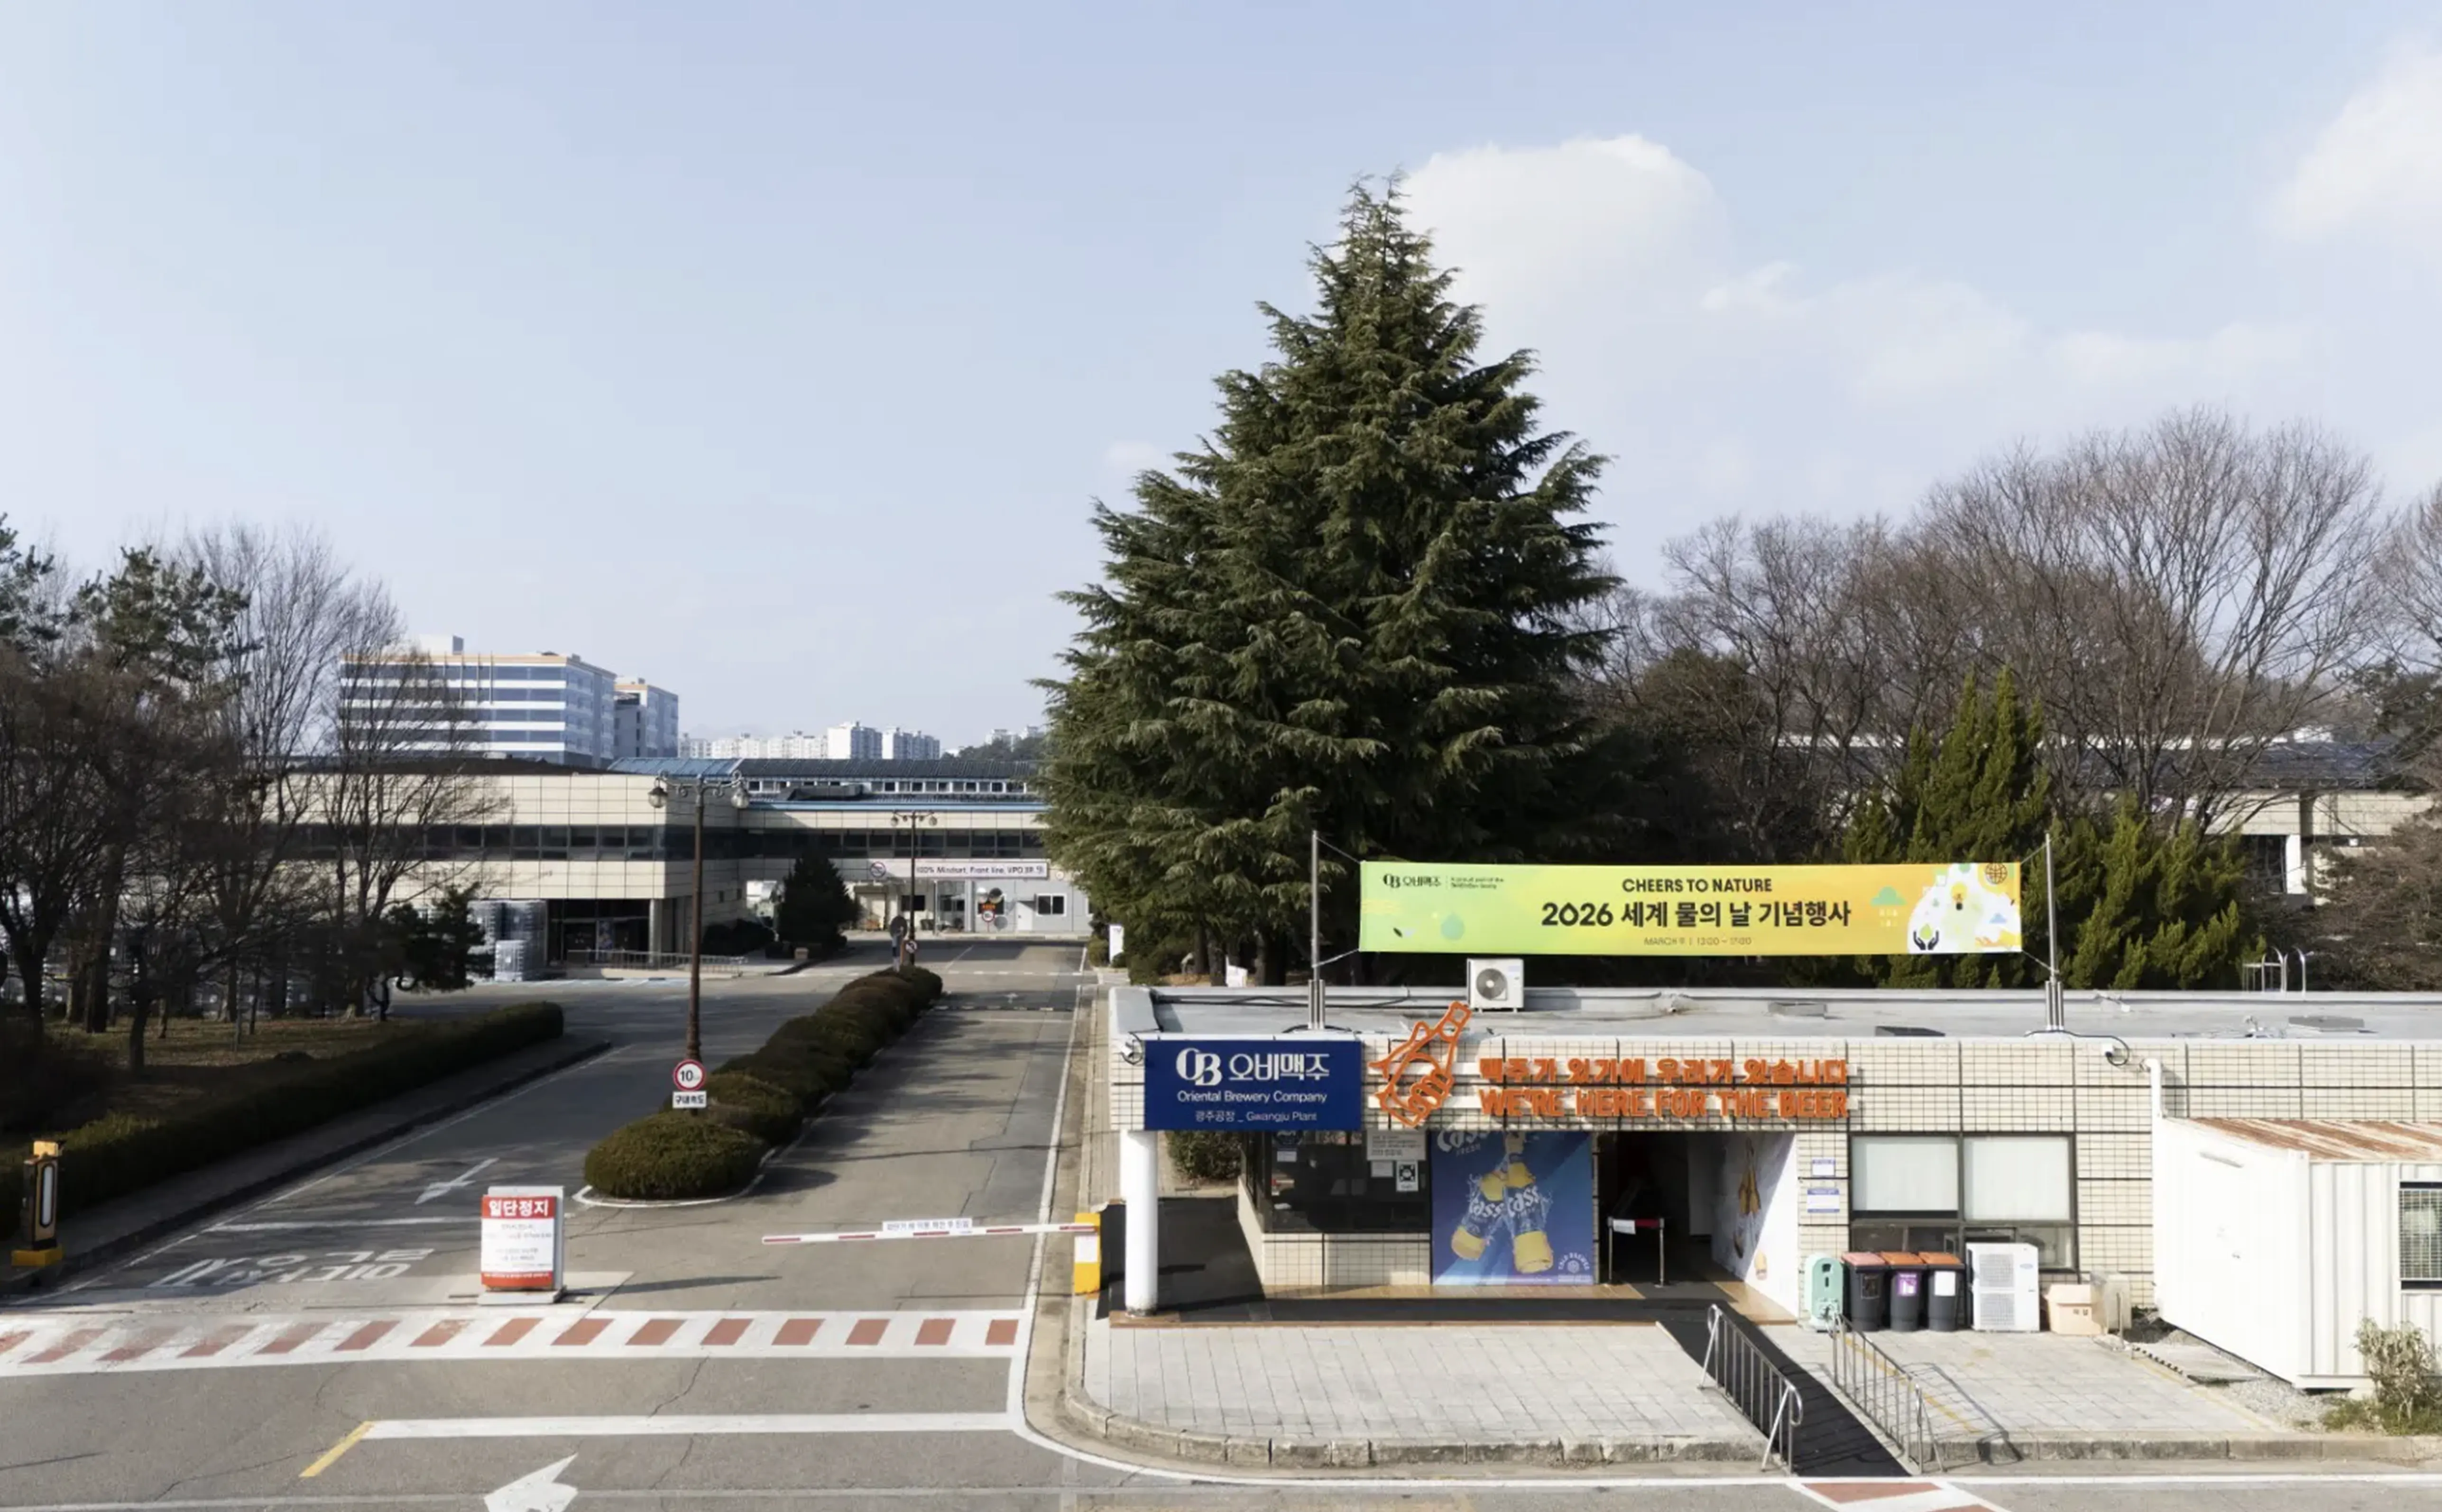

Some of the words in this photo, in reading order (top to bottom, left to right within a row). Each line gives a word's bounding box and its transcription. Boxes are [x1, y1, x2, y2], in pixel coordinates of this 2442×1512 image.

[1622, 878, 1683, 892] CHEERS
[1686, 878, 1708, 892] TO
[1713, 878, 1772, 892] NATURE
[1541, 902, 1613, 926] 2026
[1621, 901, 1668, 927] 세계
[1675, 901, 1721, 927] 물의
[1729, 901, 1752, 927] 날
[1758, 901, 1852, 926] 기념행사
[680, 1070, 693, 1081] 10
[1176, 1047, 1223, 1086] OB
[1229, 1053, 1330, 1081] 오비맥주
[1479, 1058, 1558, 1083] 맥주가
[1567, 1058, 1646, 1083] 있기에
[1656, 1058, 1733, 1083] 우리가
[1743, 1058, 1848, 1084] 있습니다
[1177, 1090, 1221, 1102] Oriental
[1224, 1090, 1271, 1104] Brewery
[1273, 1090, 1327, 1104] Company
[1479, 1089, 1565, 1117] WE'RE
[1575, 1089, 1648, 1117] HERE
[1654, 1090, 1706, 1117] FOR
[1715, 1090, 1770, 1117] THE
[1778, 1090, 1848, 1118] BEER
[1195, 1110, 1235, 1123] 광주공장
[1246, 1111, 1290, 1123] Gwangju
[1292, 1111, 1318, 1121] Plant
[489, 1199, 549, 1217] 일단정지
